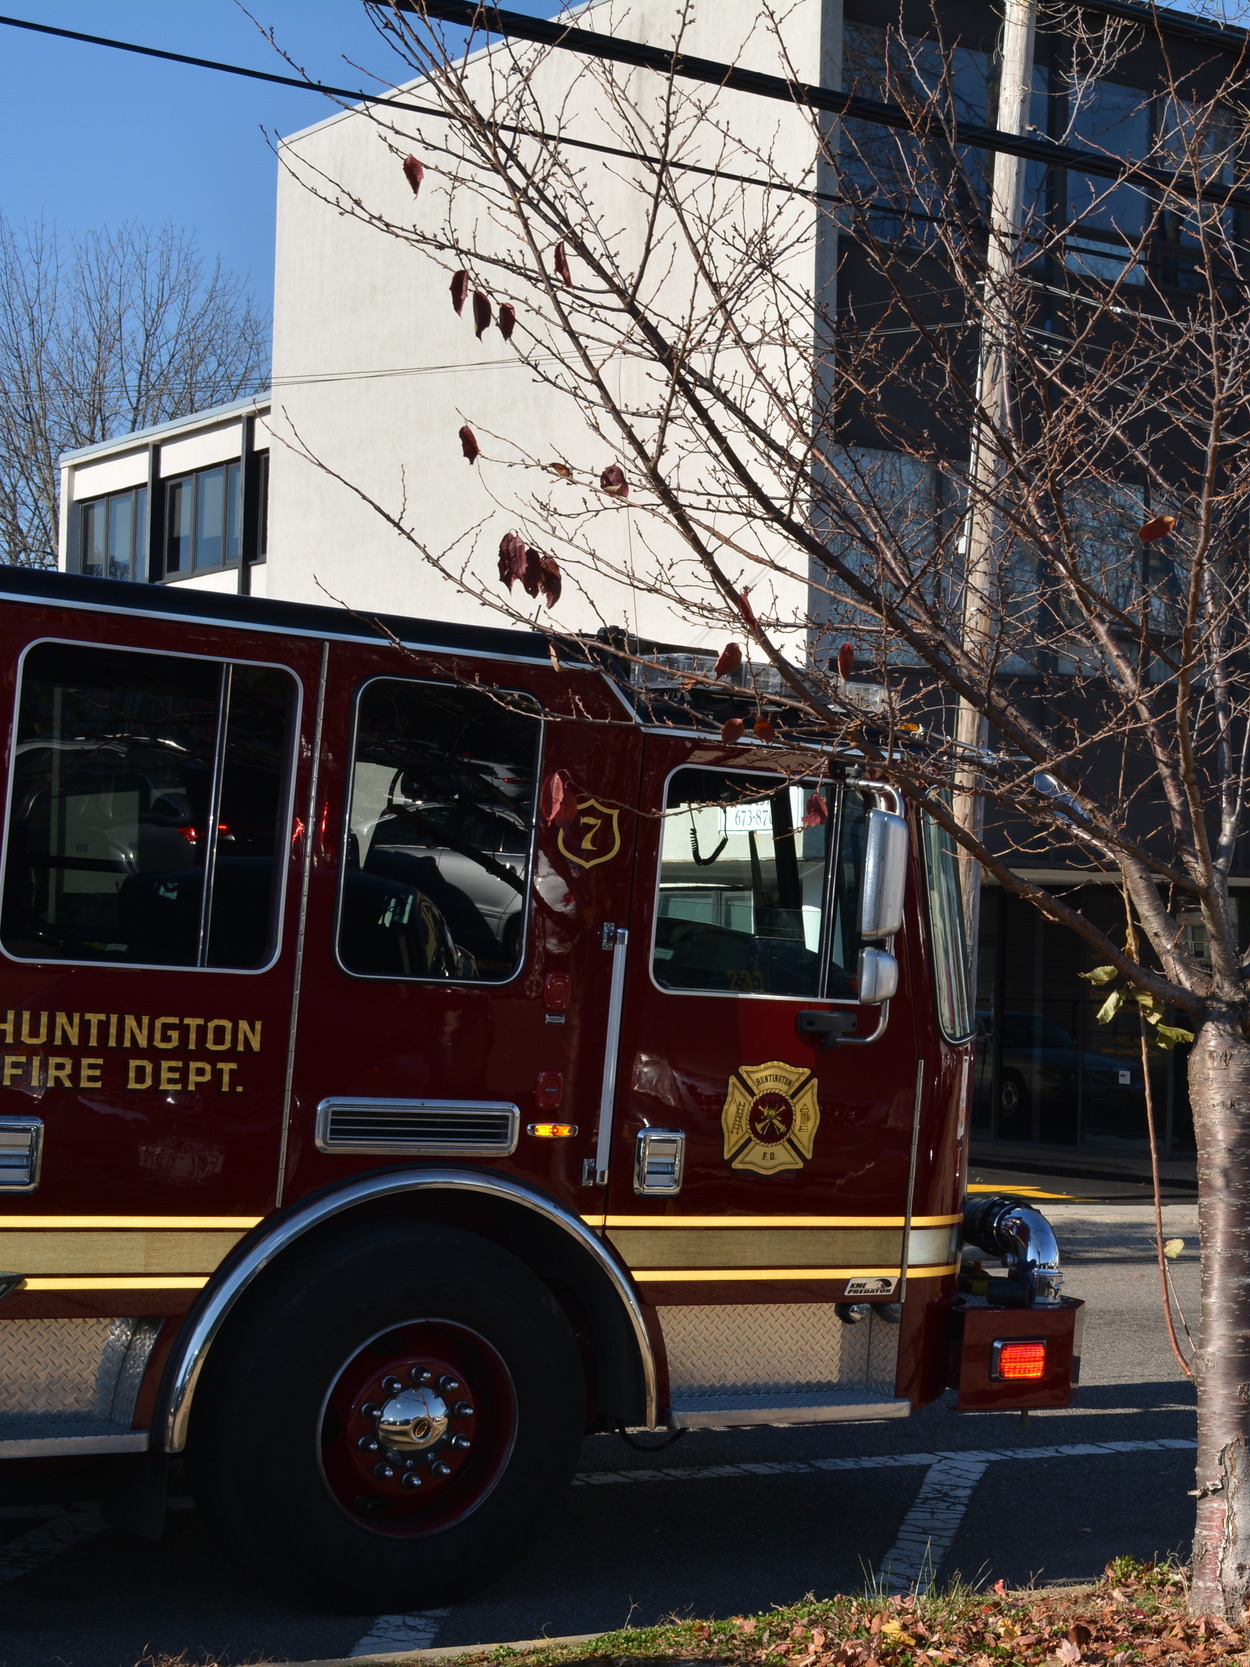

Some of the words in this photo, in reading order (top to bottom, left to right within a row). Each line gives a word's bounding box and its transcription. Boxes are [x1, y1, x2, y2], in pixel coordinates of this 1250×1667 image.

[580, 816, 601, 850] 7
[2, 1055, 104, 1088] FIRE
[126, 1059, 243, 1093] DEPT.
[755, 1074, 792, 1087] HUNTINGTON
